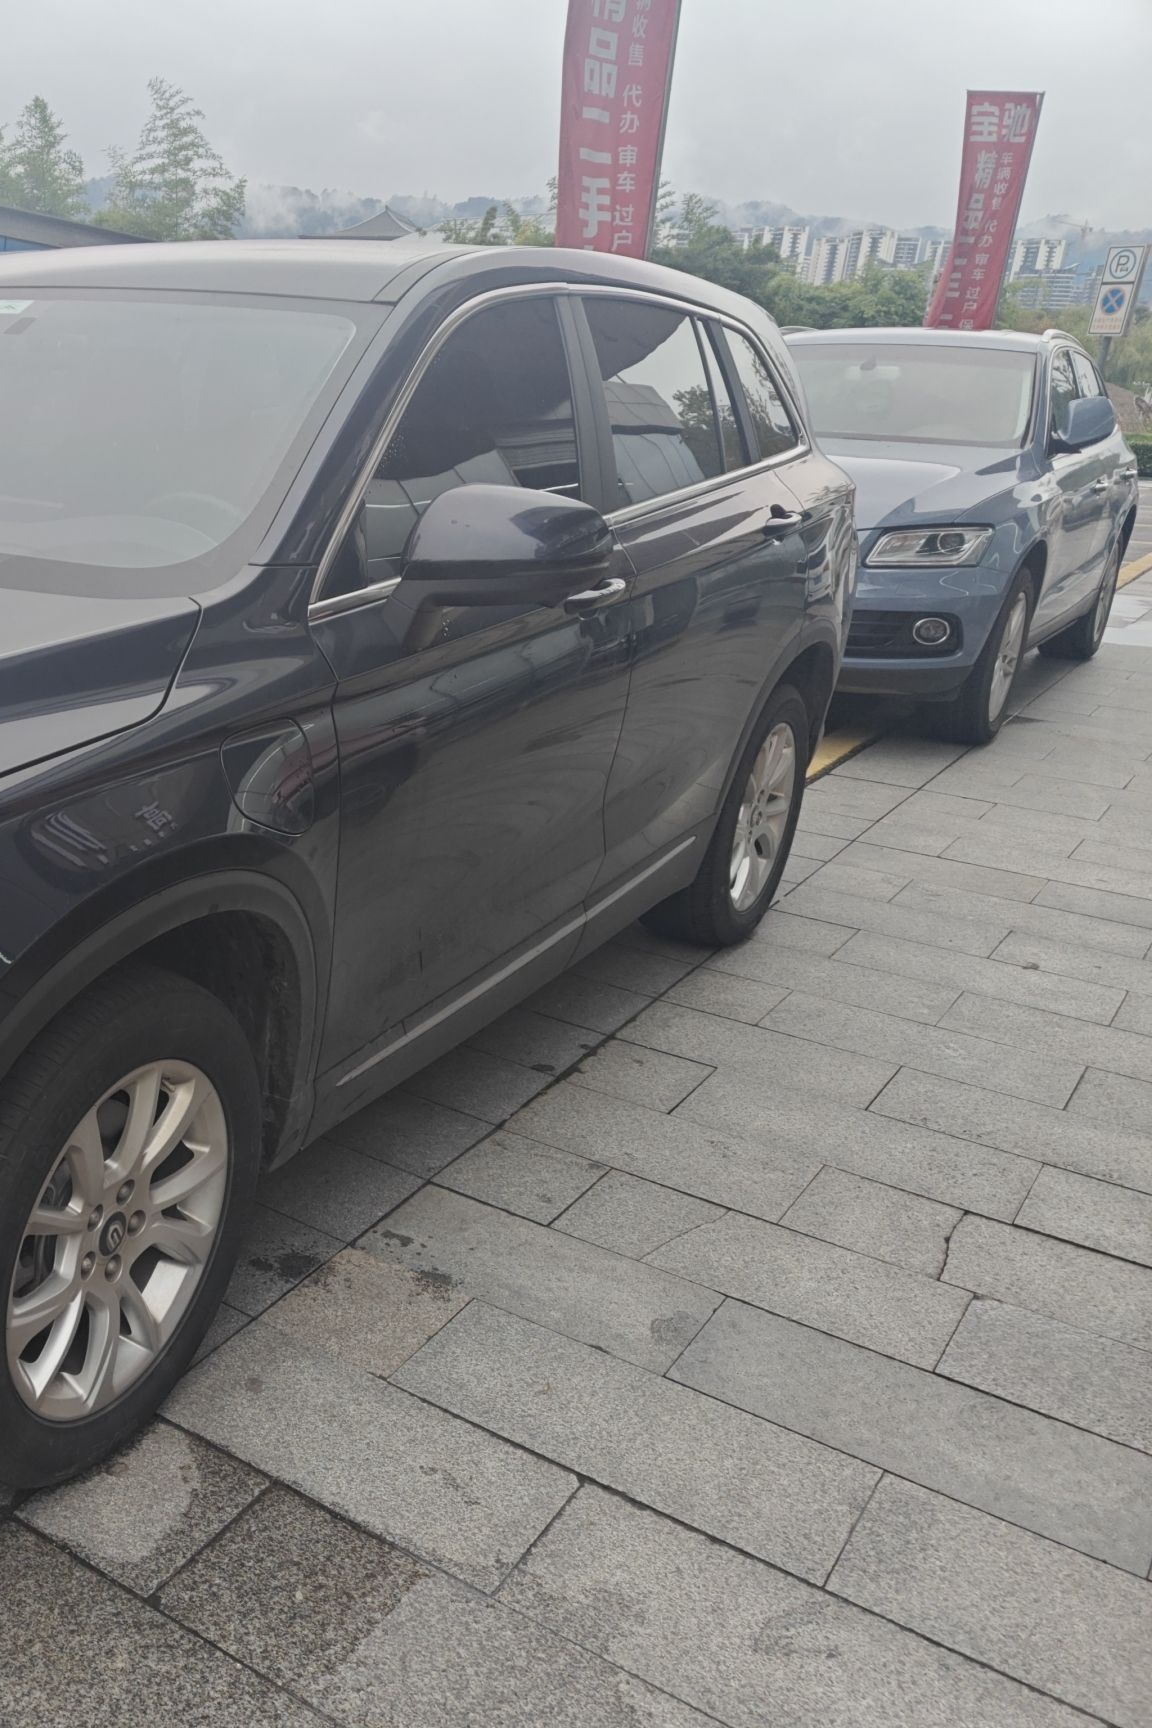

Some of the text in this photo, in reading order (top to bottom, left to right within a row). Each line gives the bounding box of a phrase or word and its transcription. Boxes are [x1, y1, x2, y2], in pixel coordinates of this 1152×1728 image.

[579, 0, 626, 252] 品二手
[619, 84, 643, 134] 代办
[969, 102, 1031, 143] 宝驰
[616, 145, 638, 193] 审车
[612, 204, 635, 252] 过户
[961, 287, 981, 313] 过户
